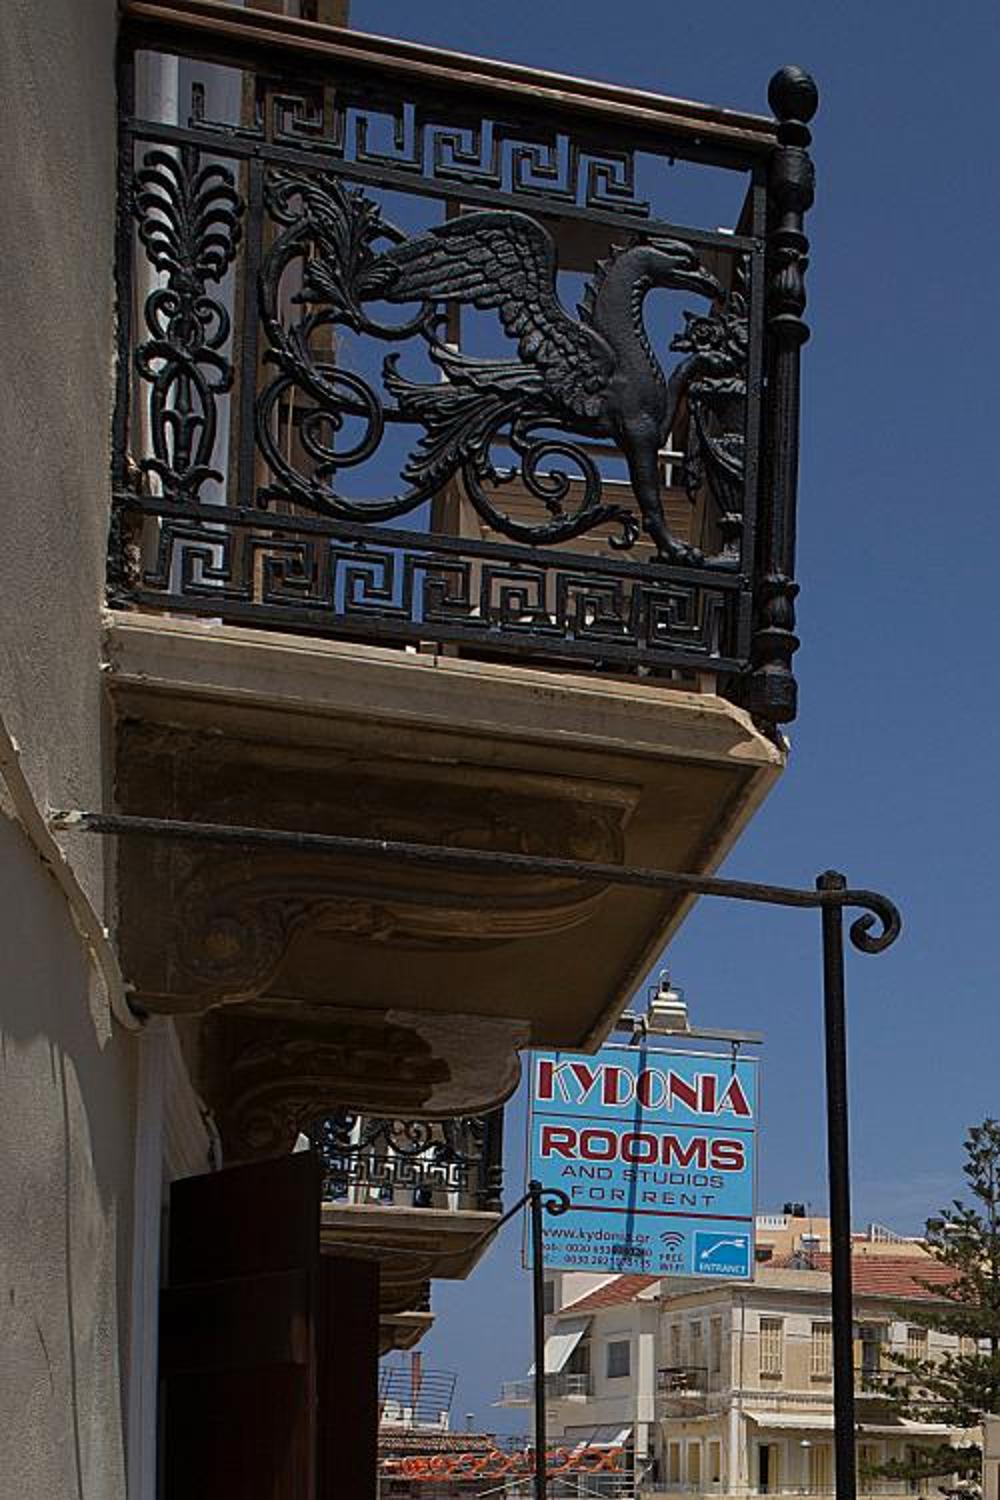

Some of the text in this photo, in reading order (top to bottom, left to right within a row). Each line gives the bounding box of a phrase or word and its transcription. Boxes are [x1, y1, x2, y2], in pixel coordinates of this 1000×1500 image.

[537, 1058, 752, 1117] KYDONIA
[540, 1124, 746, 1172] ROOMS
[561, 1164, 724, 1189] AND STUDIOS
[571, 1185, 715, 1207] FOR RENT
